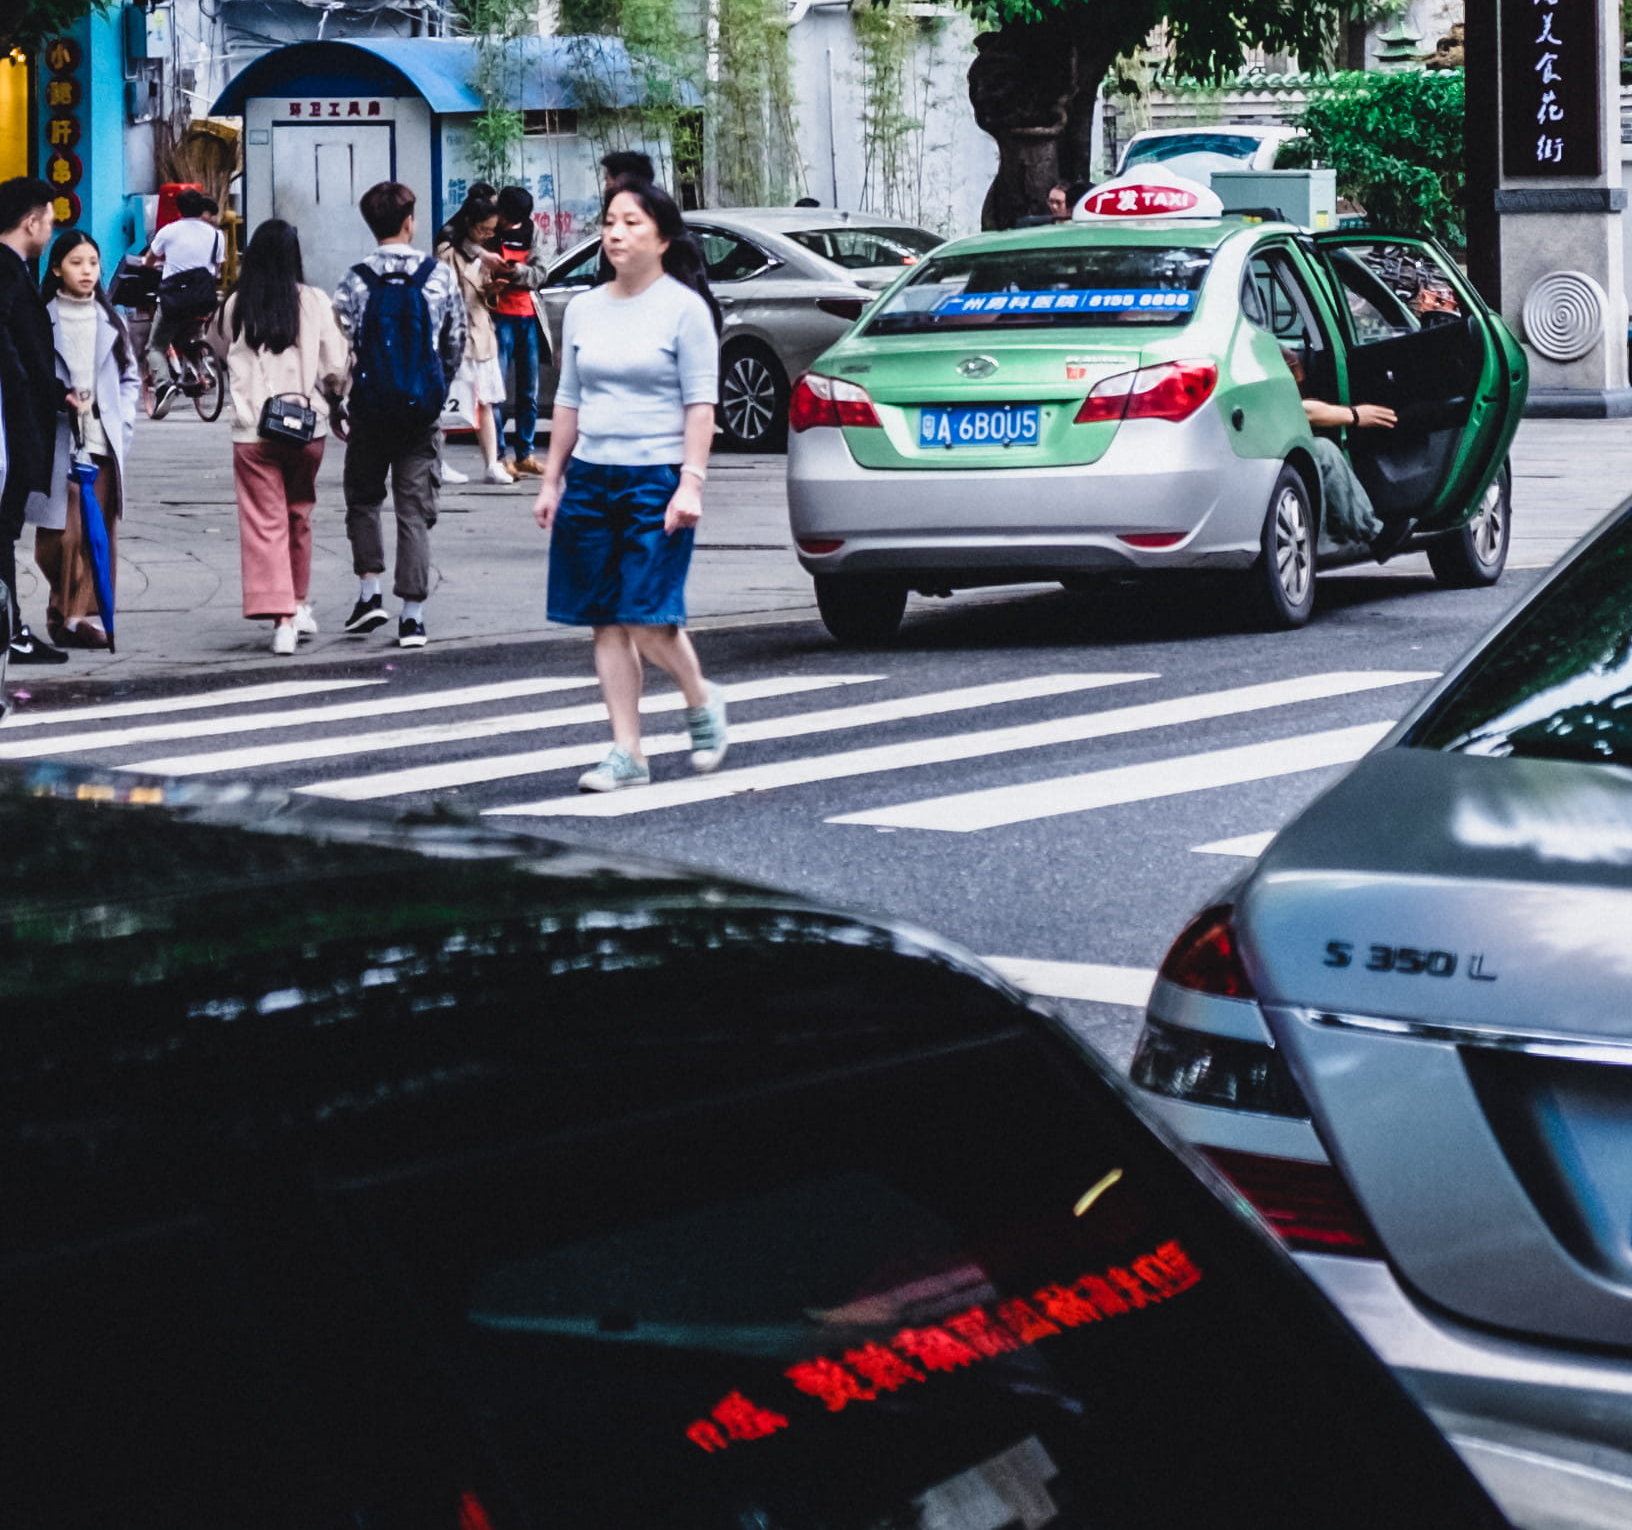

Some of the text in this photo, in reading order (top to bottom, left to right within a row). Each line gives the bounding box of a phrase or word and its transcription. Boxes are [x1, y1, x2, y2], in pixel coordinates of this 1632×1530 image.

[1143, 192, 1188, 208] TAXI
[1323, 941, 1498, 982] S 350 L
